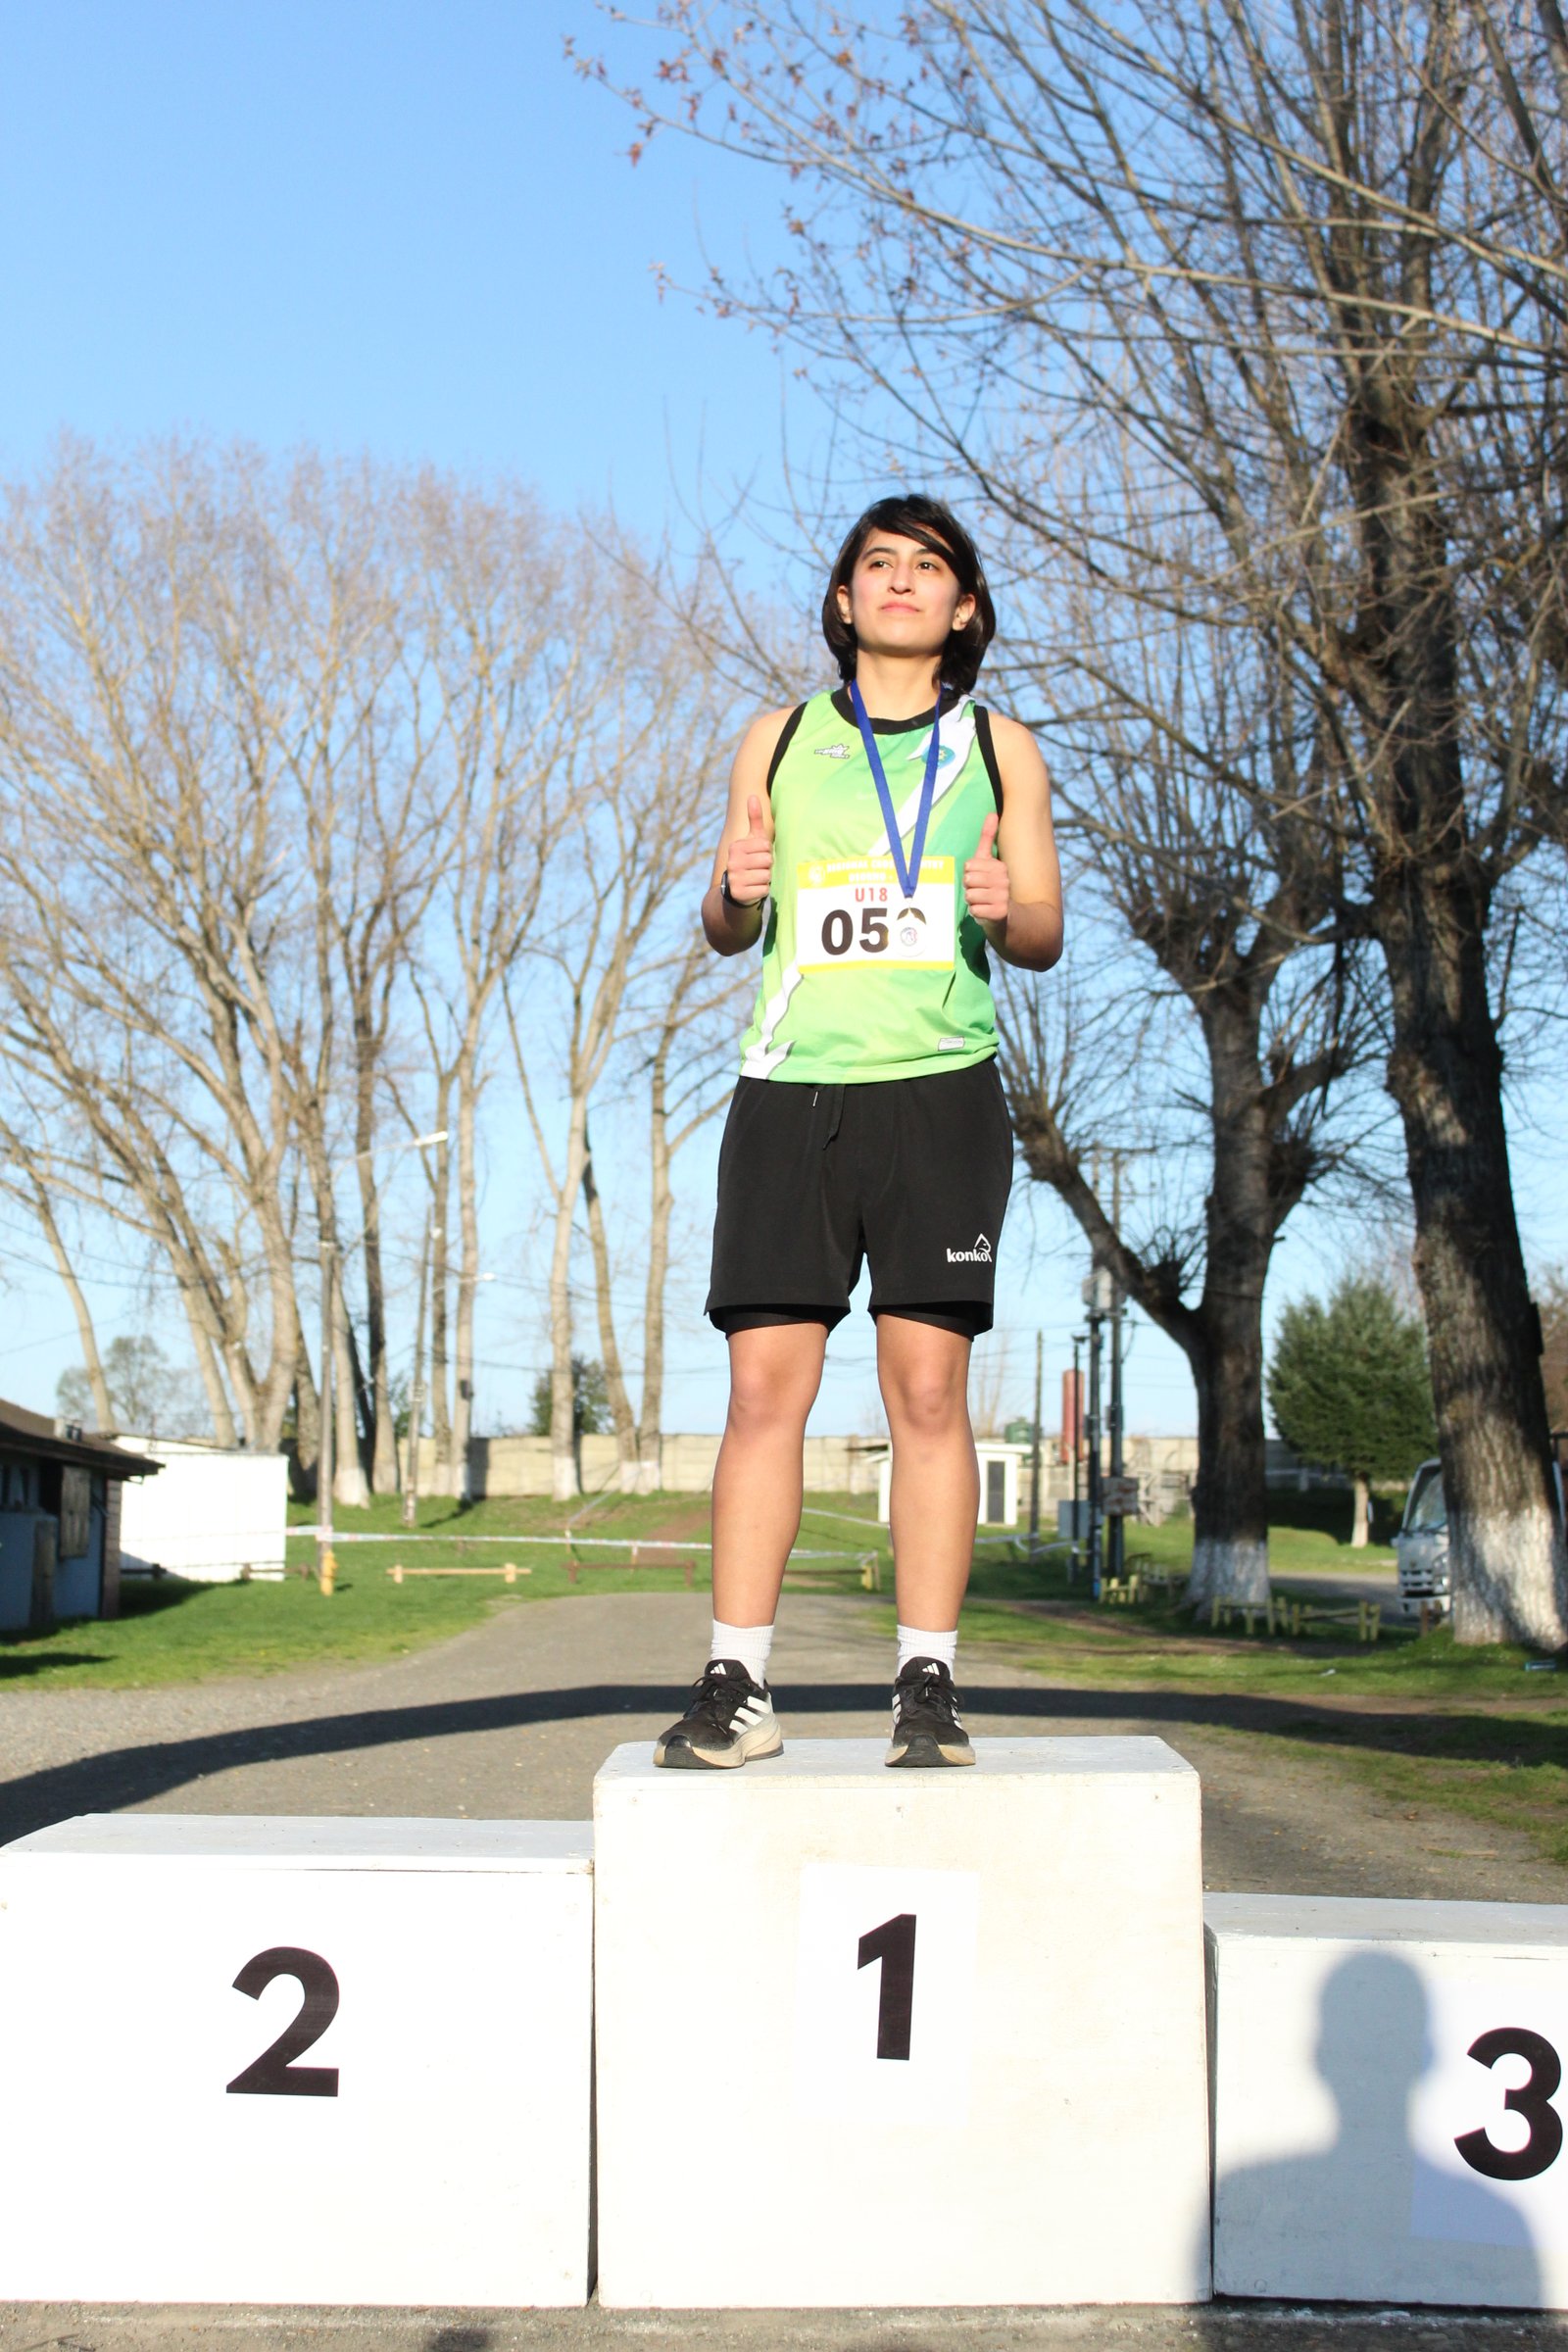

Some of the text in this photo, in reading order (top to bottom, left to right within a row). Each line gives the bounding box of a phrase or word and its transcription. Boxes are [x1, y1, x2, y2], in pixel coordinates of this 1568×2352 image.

[821, 907, 927, 956] 05
[855, 887, 888, 903] U18
[226, 1946, 340, 2097] 2
[857, 1913, 916, 2061] 1
[1453, 2027, 1563, 2180] 3
